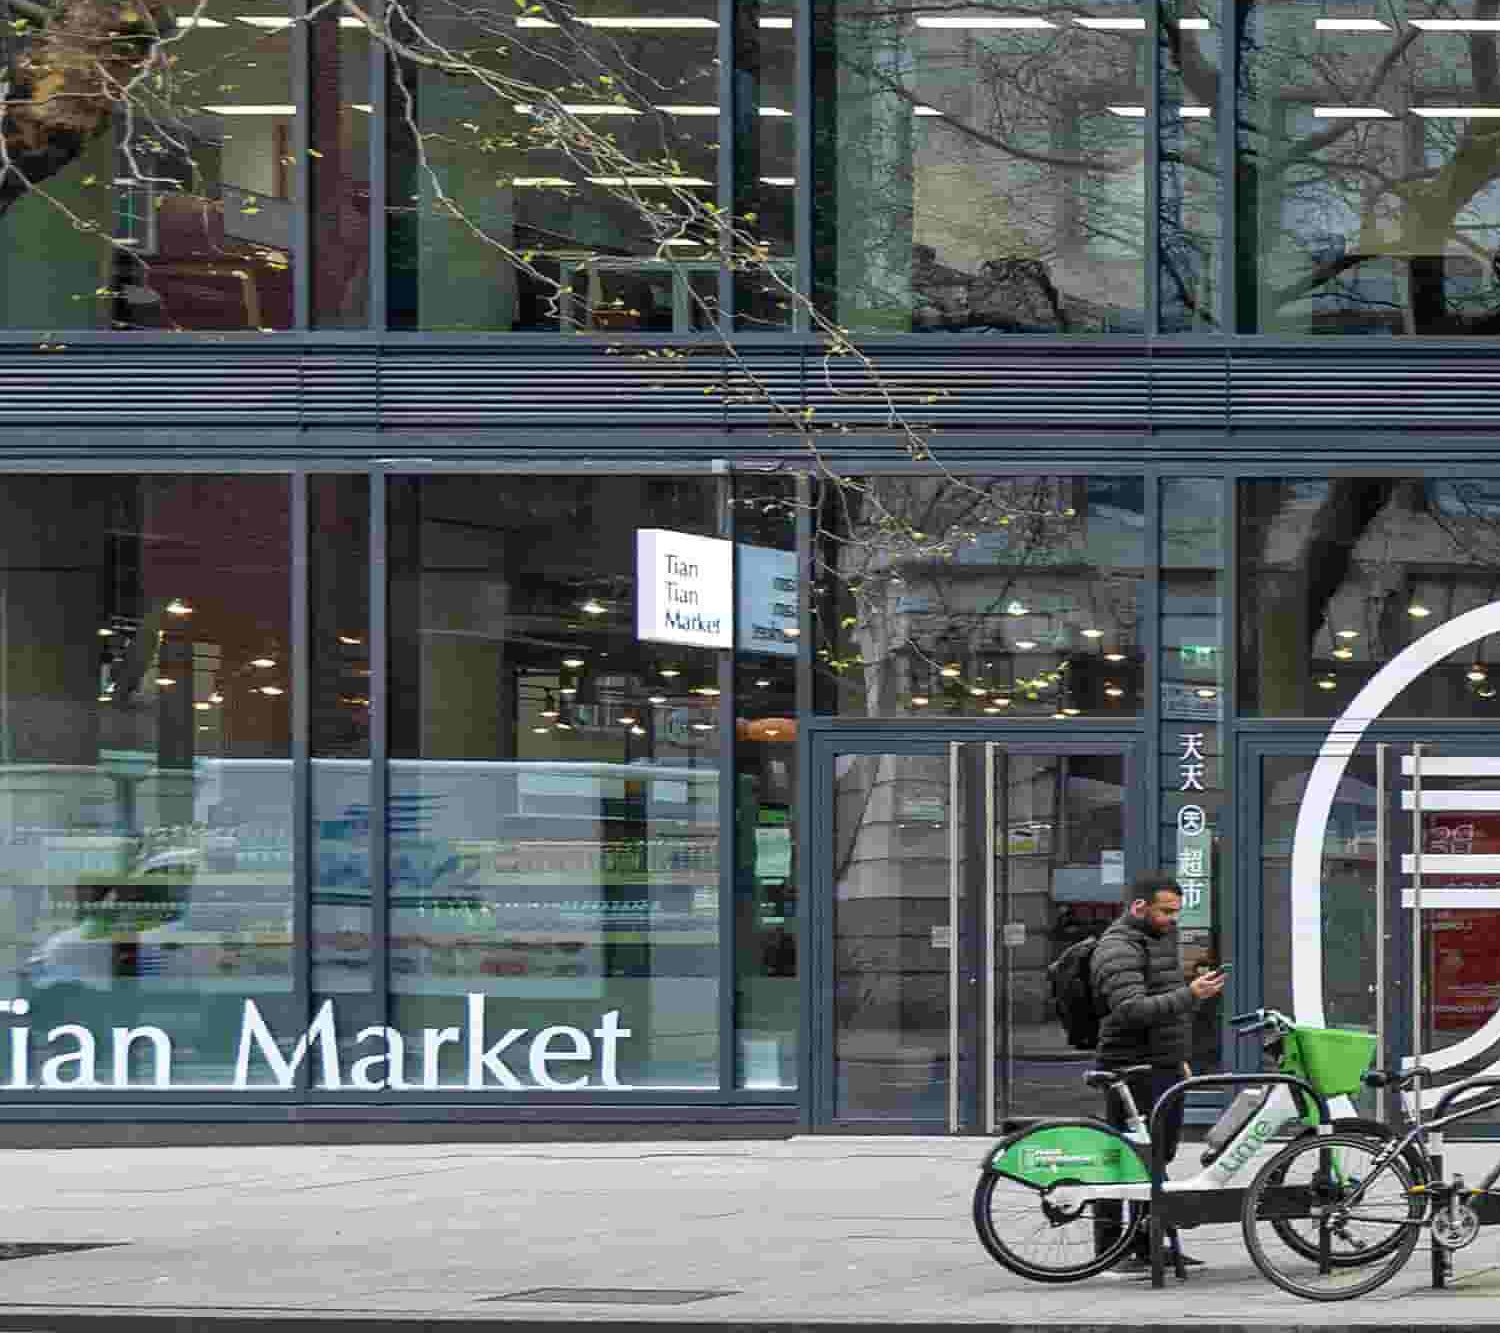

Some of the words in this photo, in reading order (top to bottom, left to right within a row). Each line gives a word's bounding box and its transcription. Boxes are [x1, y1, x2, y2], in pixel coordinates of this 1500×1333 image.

[664, 553, 699, 577] Tian
[664, 580, 699, 605] Tian
[664, 609, 721, 634] Market
[0, 997, 173, 1090] ian
[232, 993, 633, 1091] Market
